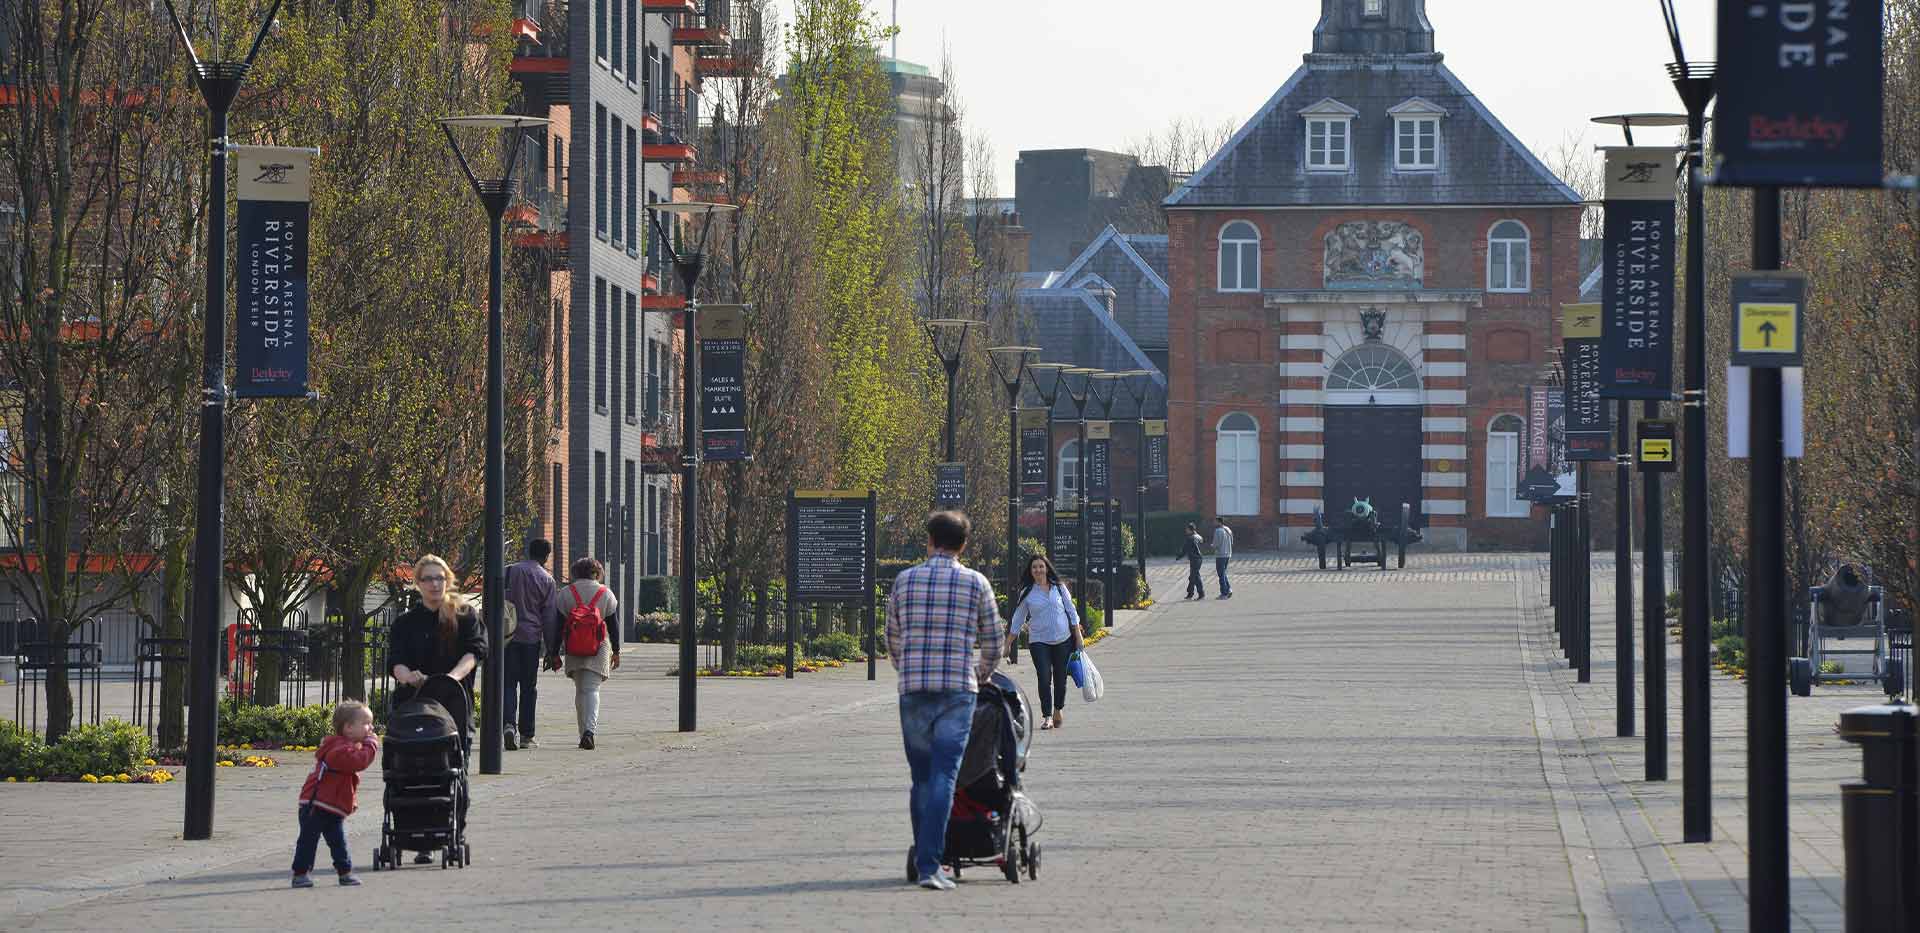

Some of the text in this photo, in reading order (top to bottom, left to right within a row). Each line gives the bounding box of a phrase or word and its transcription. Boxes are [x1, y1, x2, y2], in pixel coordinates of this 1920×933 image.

[251, 243, 260, 294] LONDON
[264, 221, 280, 348] RIVERSIDE
[283, 221, 295, 348] ROYAL ARSENAL
[1615, 243, 1625, 295] LONDON
[1628, 220, 1647, 349] RIVERSIDE
[1648, 220, 1661, 348] ROYAL ARSENAL
[1533, 390, 1545, 455] HERITAGE
[1580, 344, 1592, 425] RIVERSIDE
